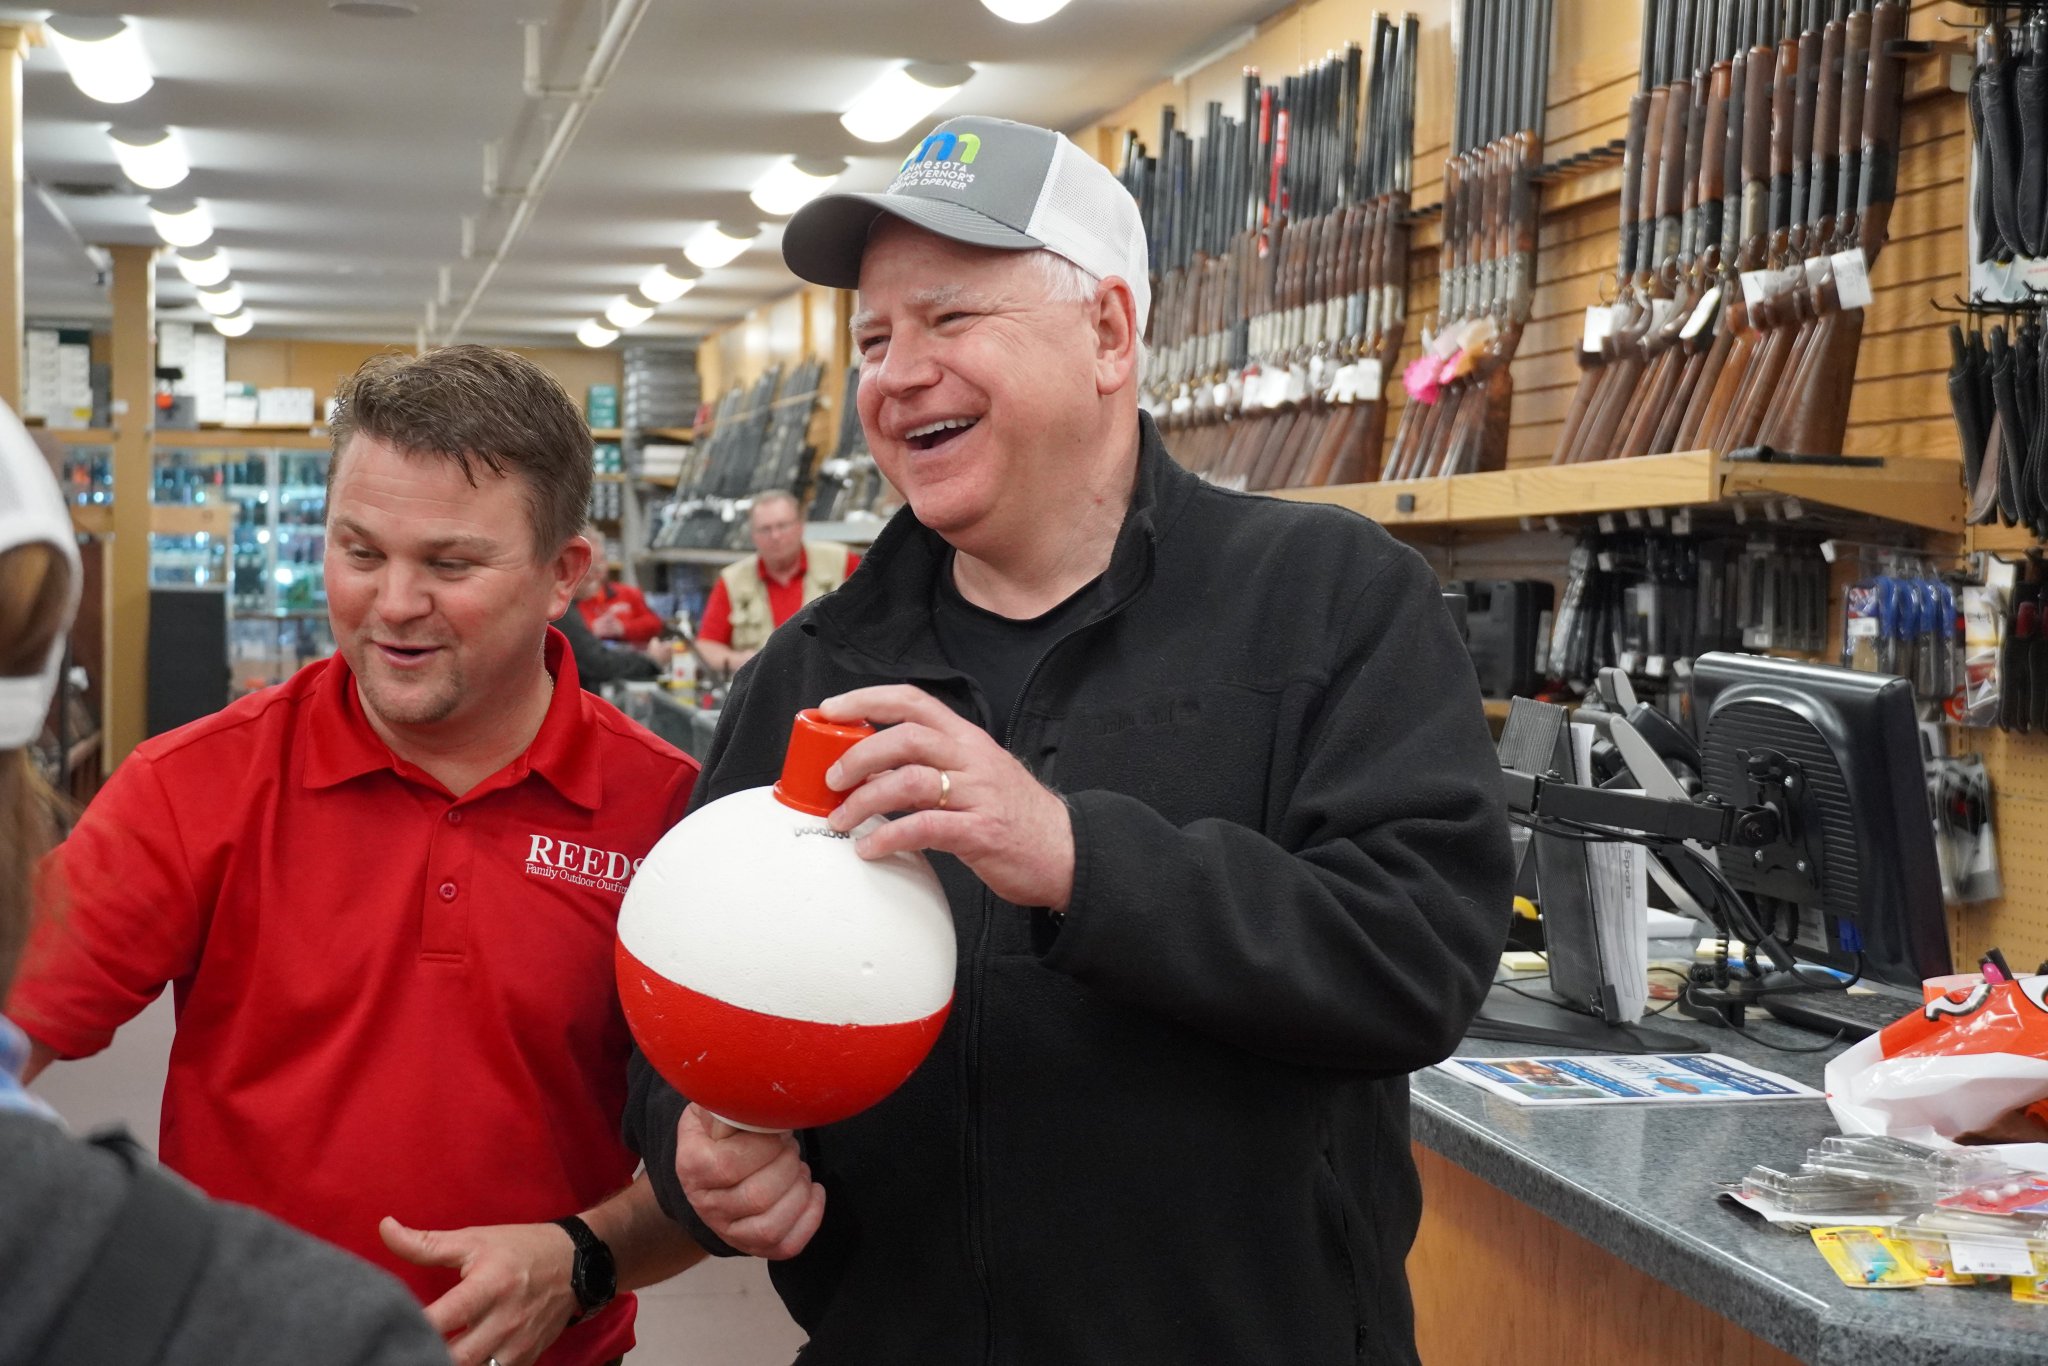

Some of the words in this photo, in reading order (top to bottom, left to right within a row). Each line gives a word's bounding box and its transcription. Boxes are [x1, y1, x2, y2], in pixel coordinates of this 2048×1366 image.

[920, 178, 967, 190] OPENER
[526, 863, 558, 880] Family
[559, 869, 595, 888] Outdoor
[1624, 849, 1632, 899] Sports
